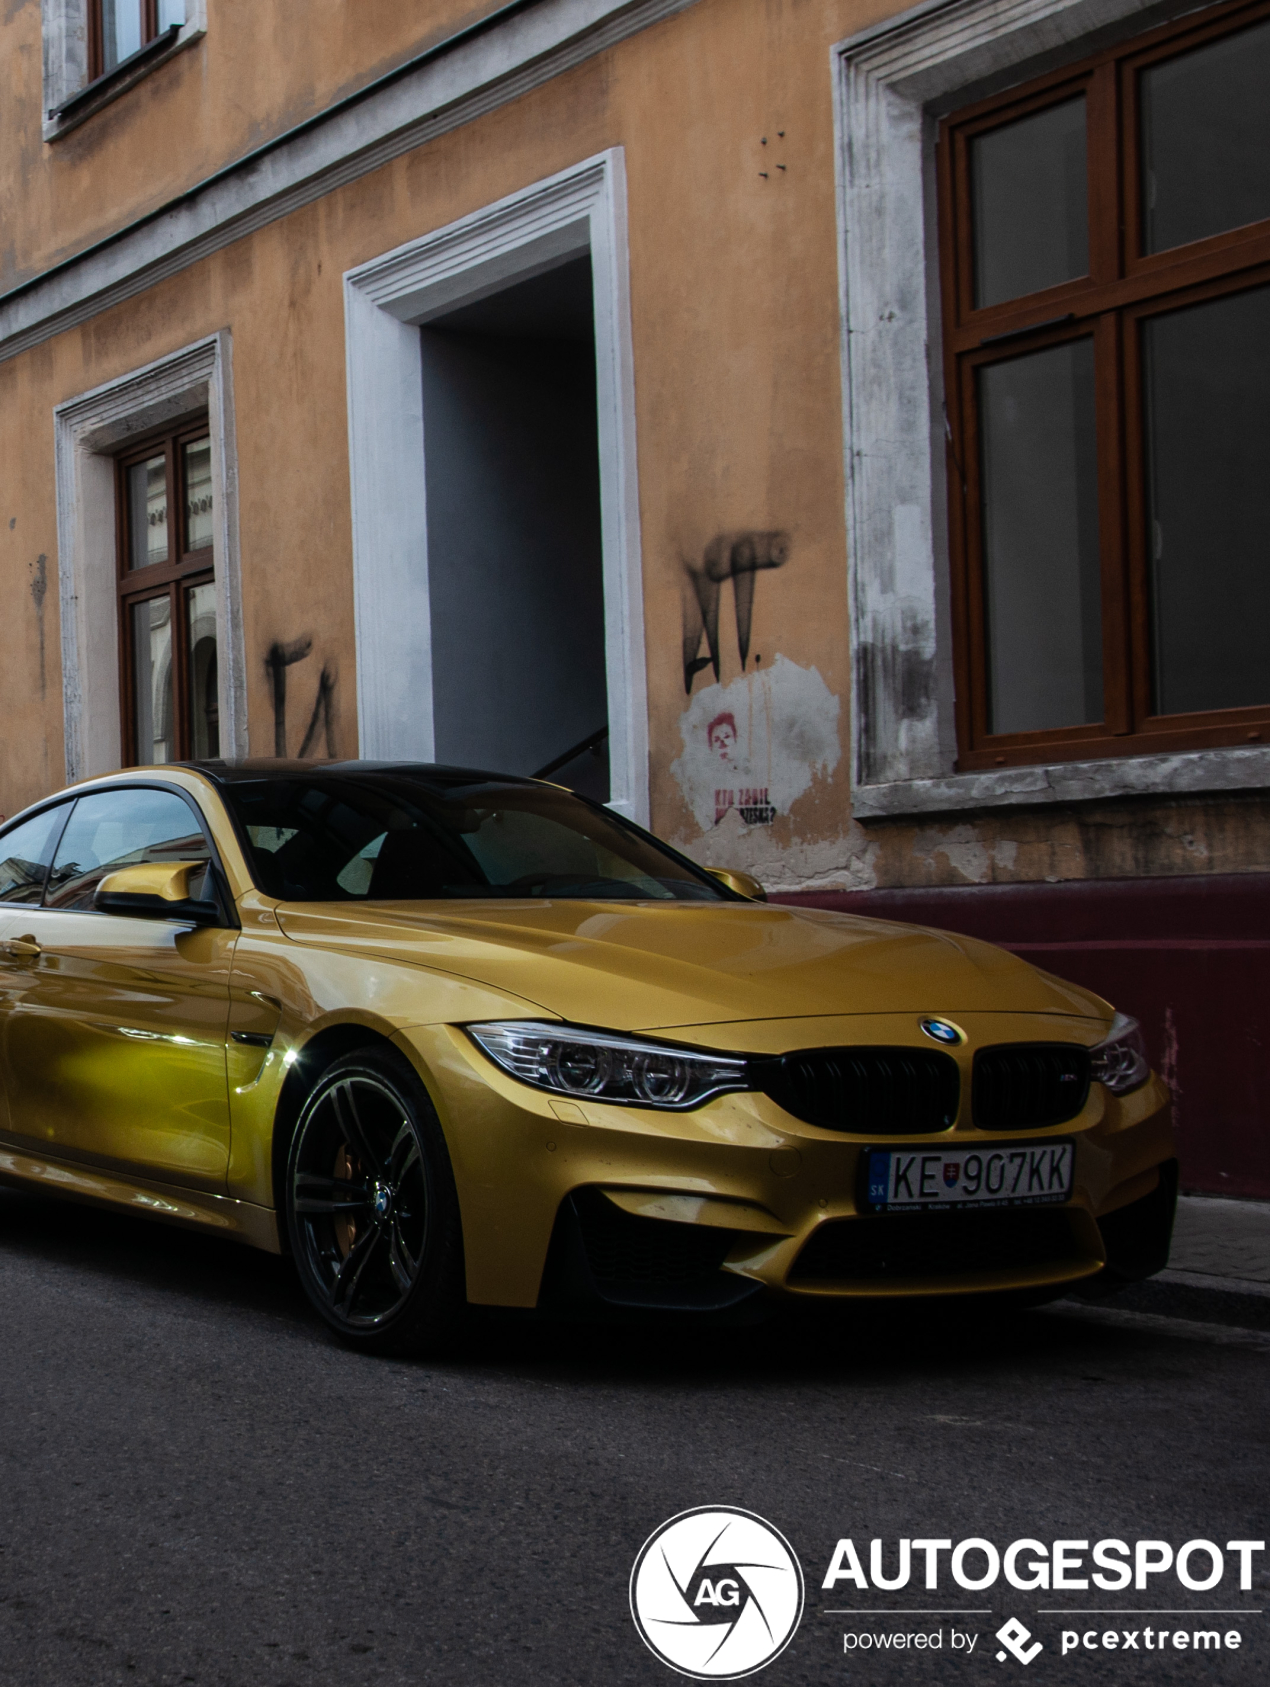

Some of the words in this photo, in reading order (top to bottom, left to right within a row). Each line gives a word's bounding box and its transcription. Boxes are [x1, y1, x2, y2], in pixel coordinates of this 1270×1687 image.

[893, 1155, 942, 1199] KE
[962, 1148, 1069, 1196] 907KK
[870, 1184, 884, 1197] SK
